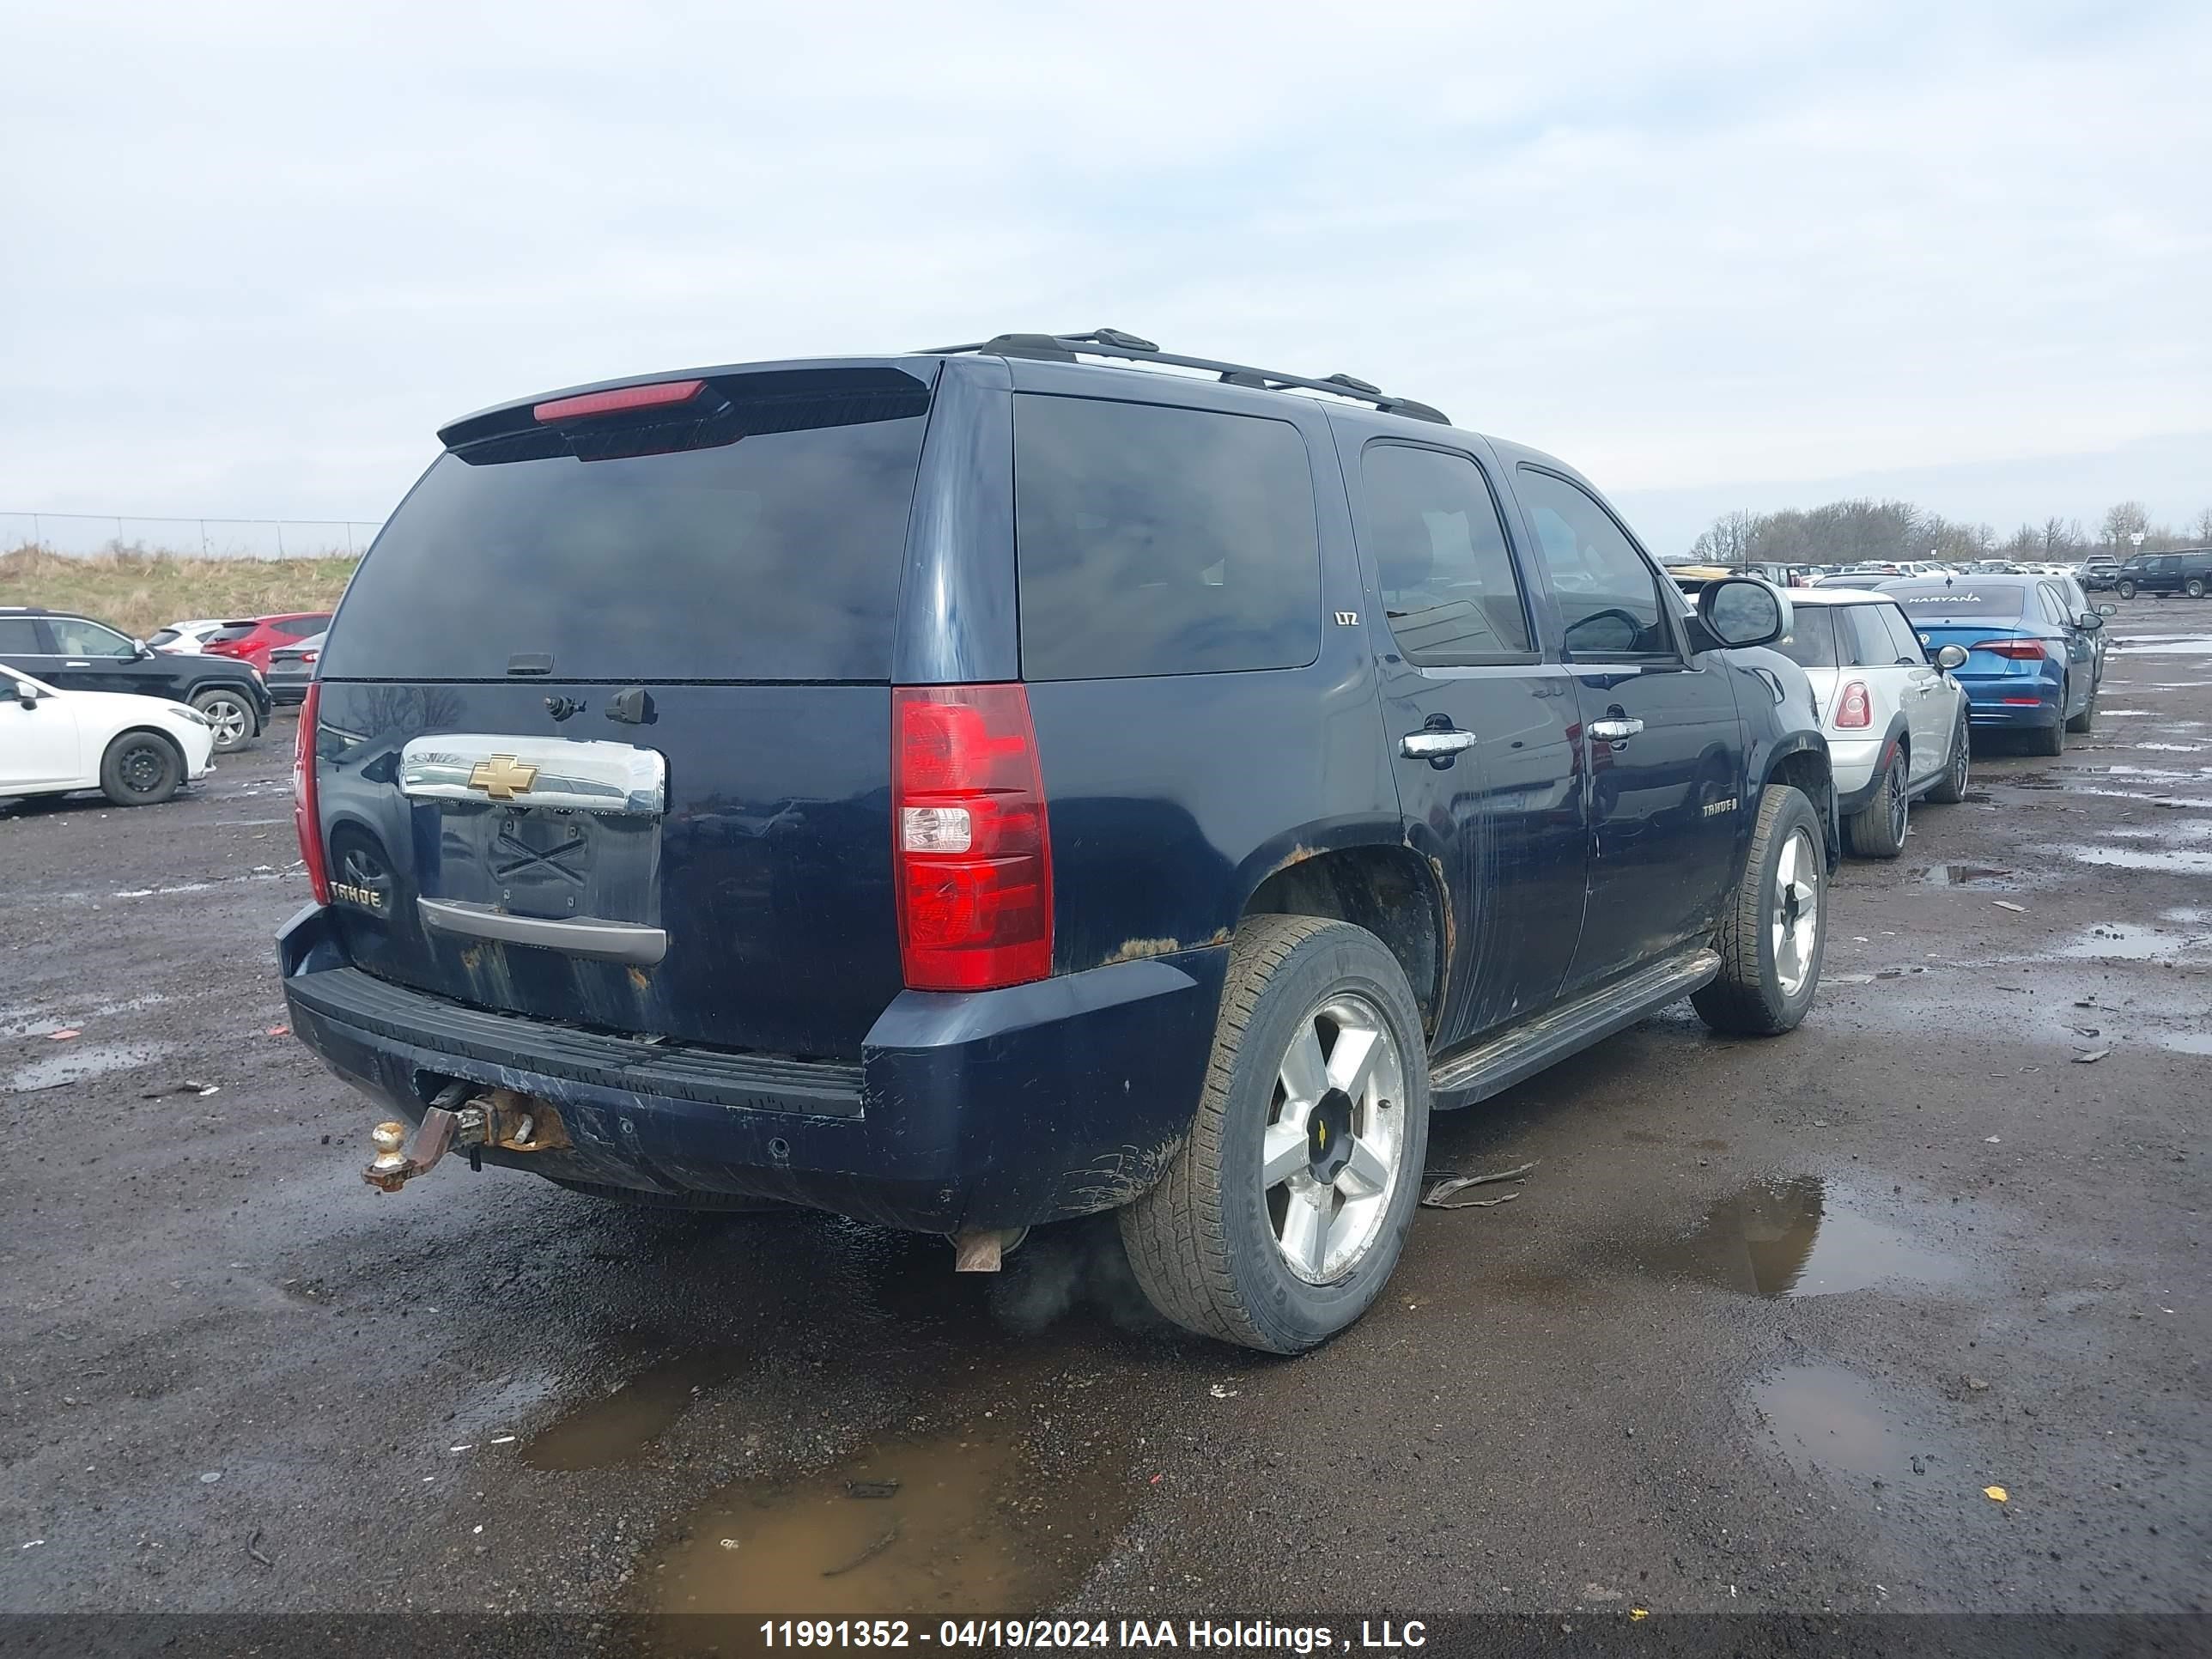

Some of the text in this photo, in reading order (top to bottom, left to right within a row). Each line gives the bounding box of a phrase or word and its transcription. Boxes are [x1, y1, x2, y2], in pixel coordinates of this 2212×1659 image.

[1909, 591, 1982, 605] HARYANA
[1333, 611, 1359, 626] LTZ
[1703, 799, 1732, 817] TAHOE
[330, 881, 383, 908] TAHOE
